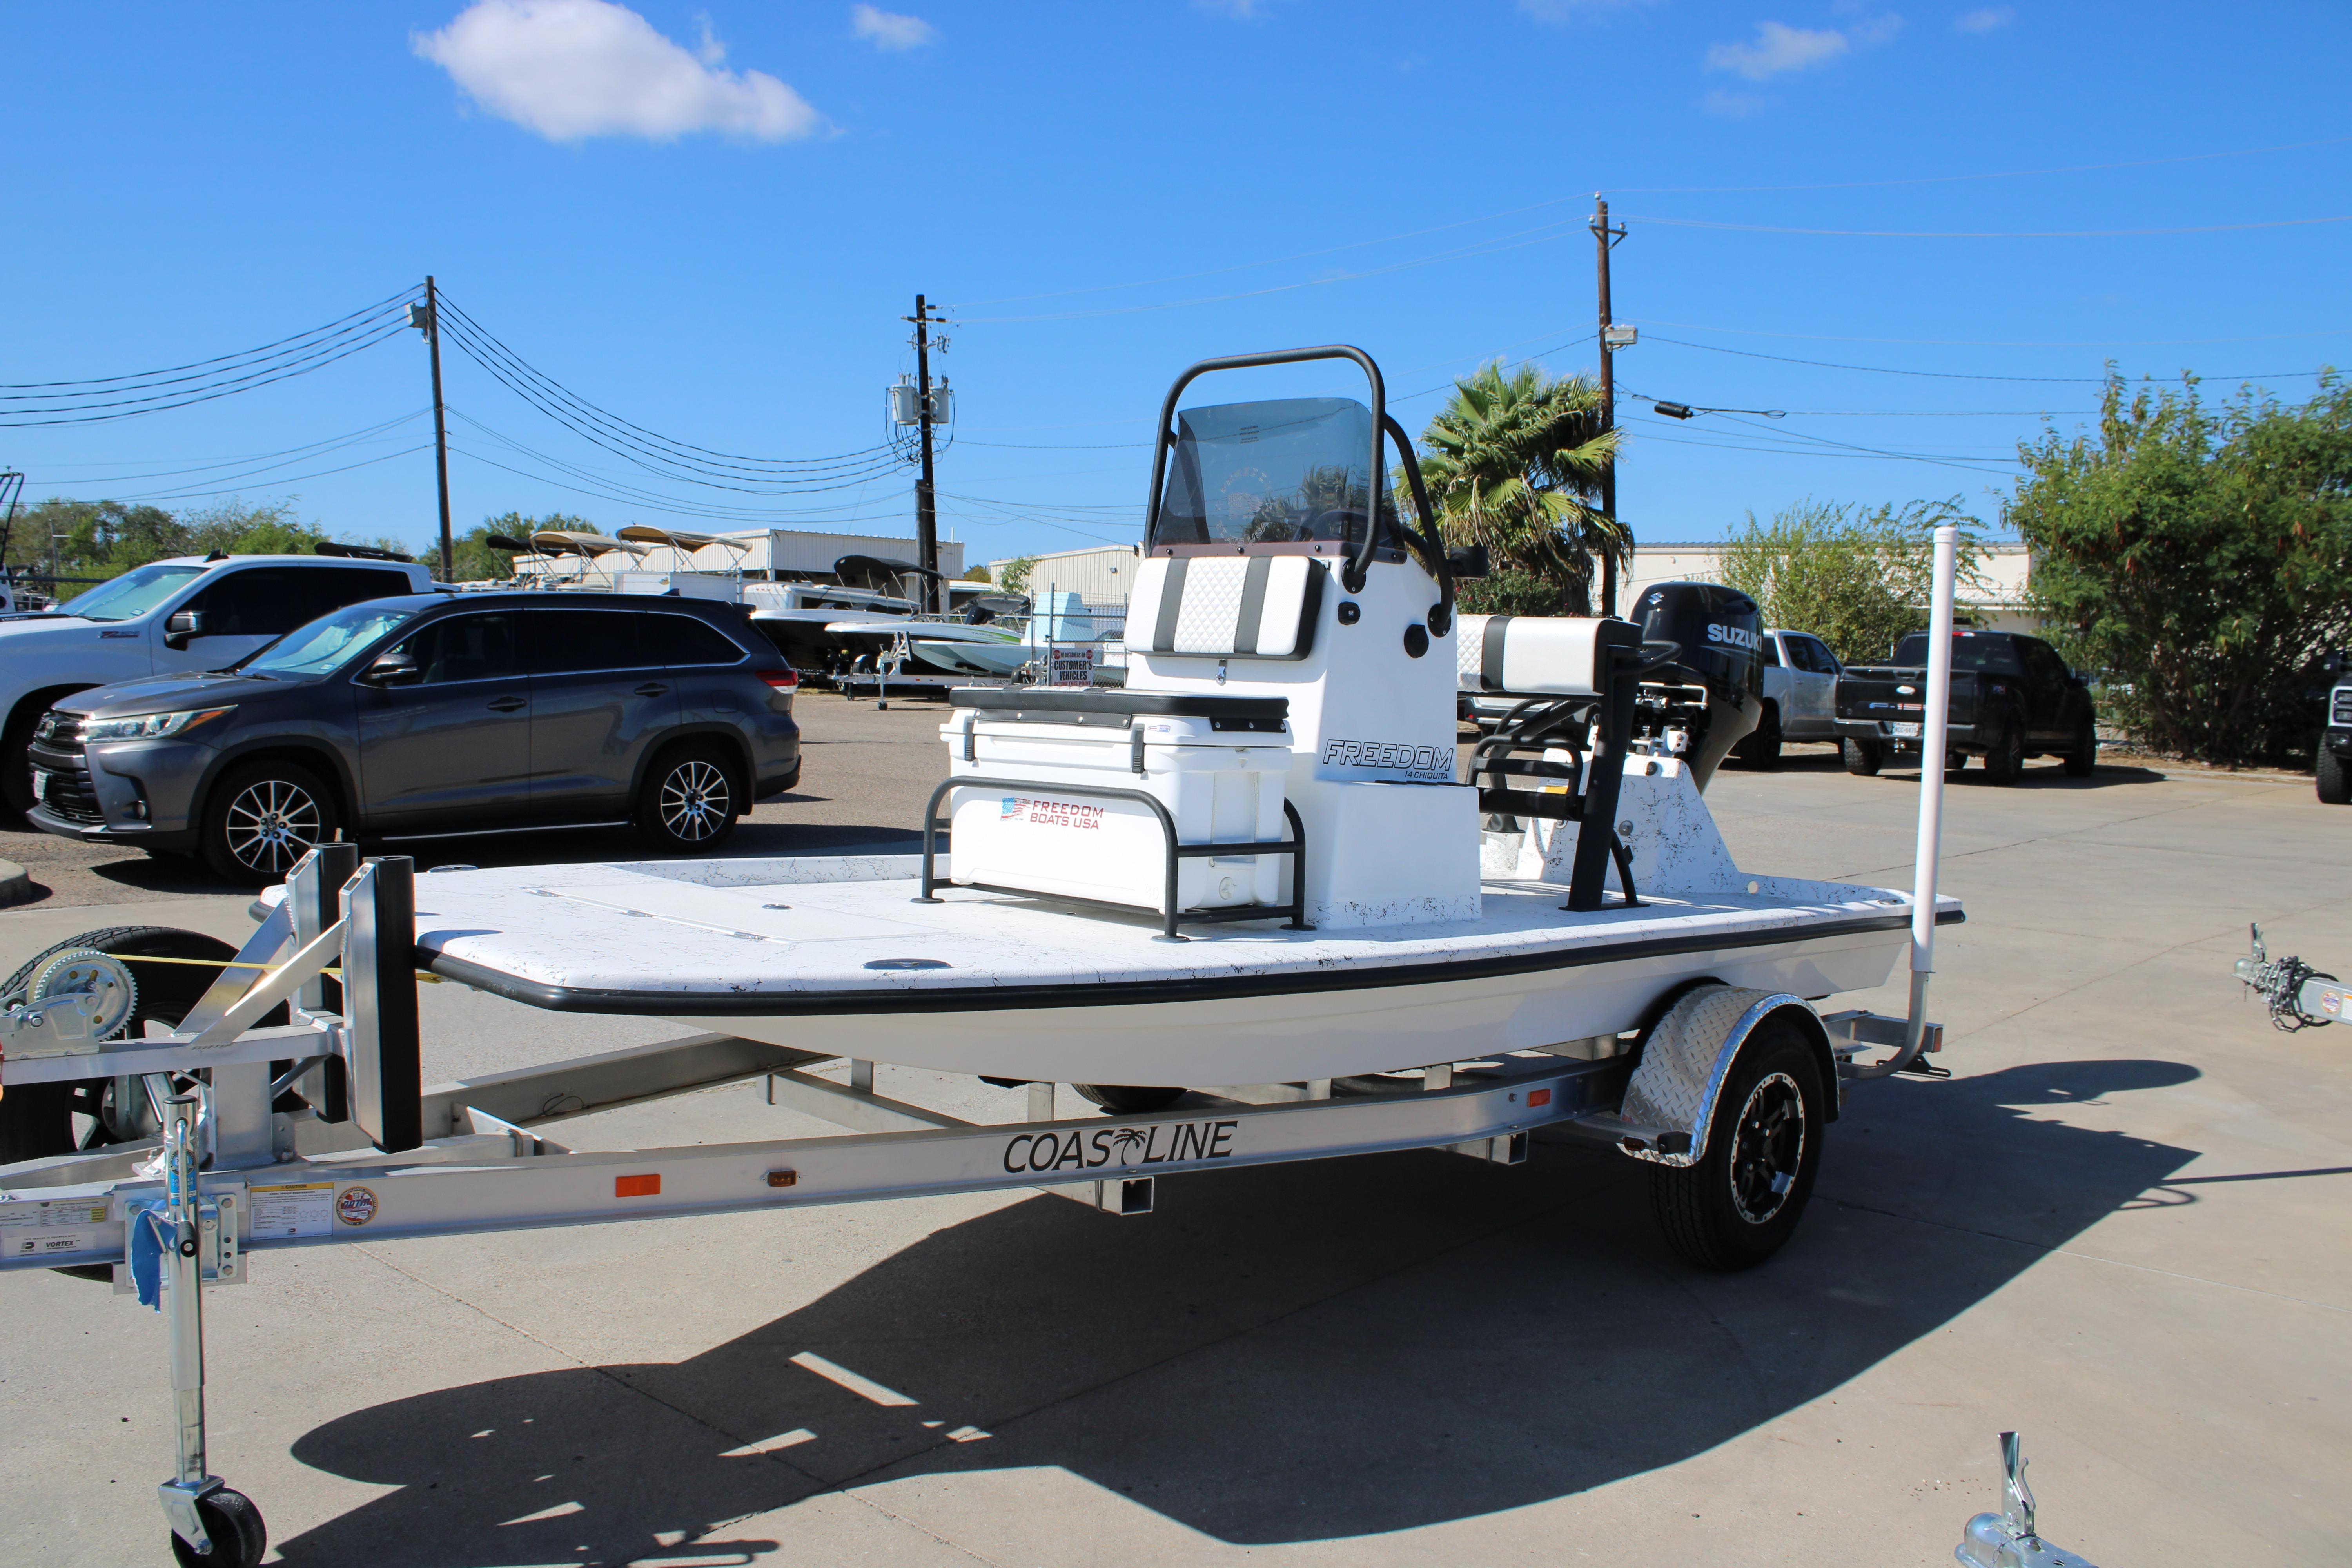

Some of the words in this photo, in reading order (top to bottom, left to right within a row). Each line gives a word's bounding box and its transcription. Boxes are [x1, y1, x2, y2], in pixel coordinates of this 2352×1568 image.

[1248, 522, 1269, 544] USA
[1708, 624, 1762, 652] SUZUKI
[1054, 661, 1092, 670] CUSTOMER'S
[1060, 671, 1087, 680] VEHICLES
[1323, 739, 1454, 771] FREEDOM
[1414, 771, 1448, 780] CHIQUITA
[1033, 800, 1104, 818] FREEDOM
[1030, 813, 1069, 826] BOATS
[1073, 818, 1099, 830] USA
